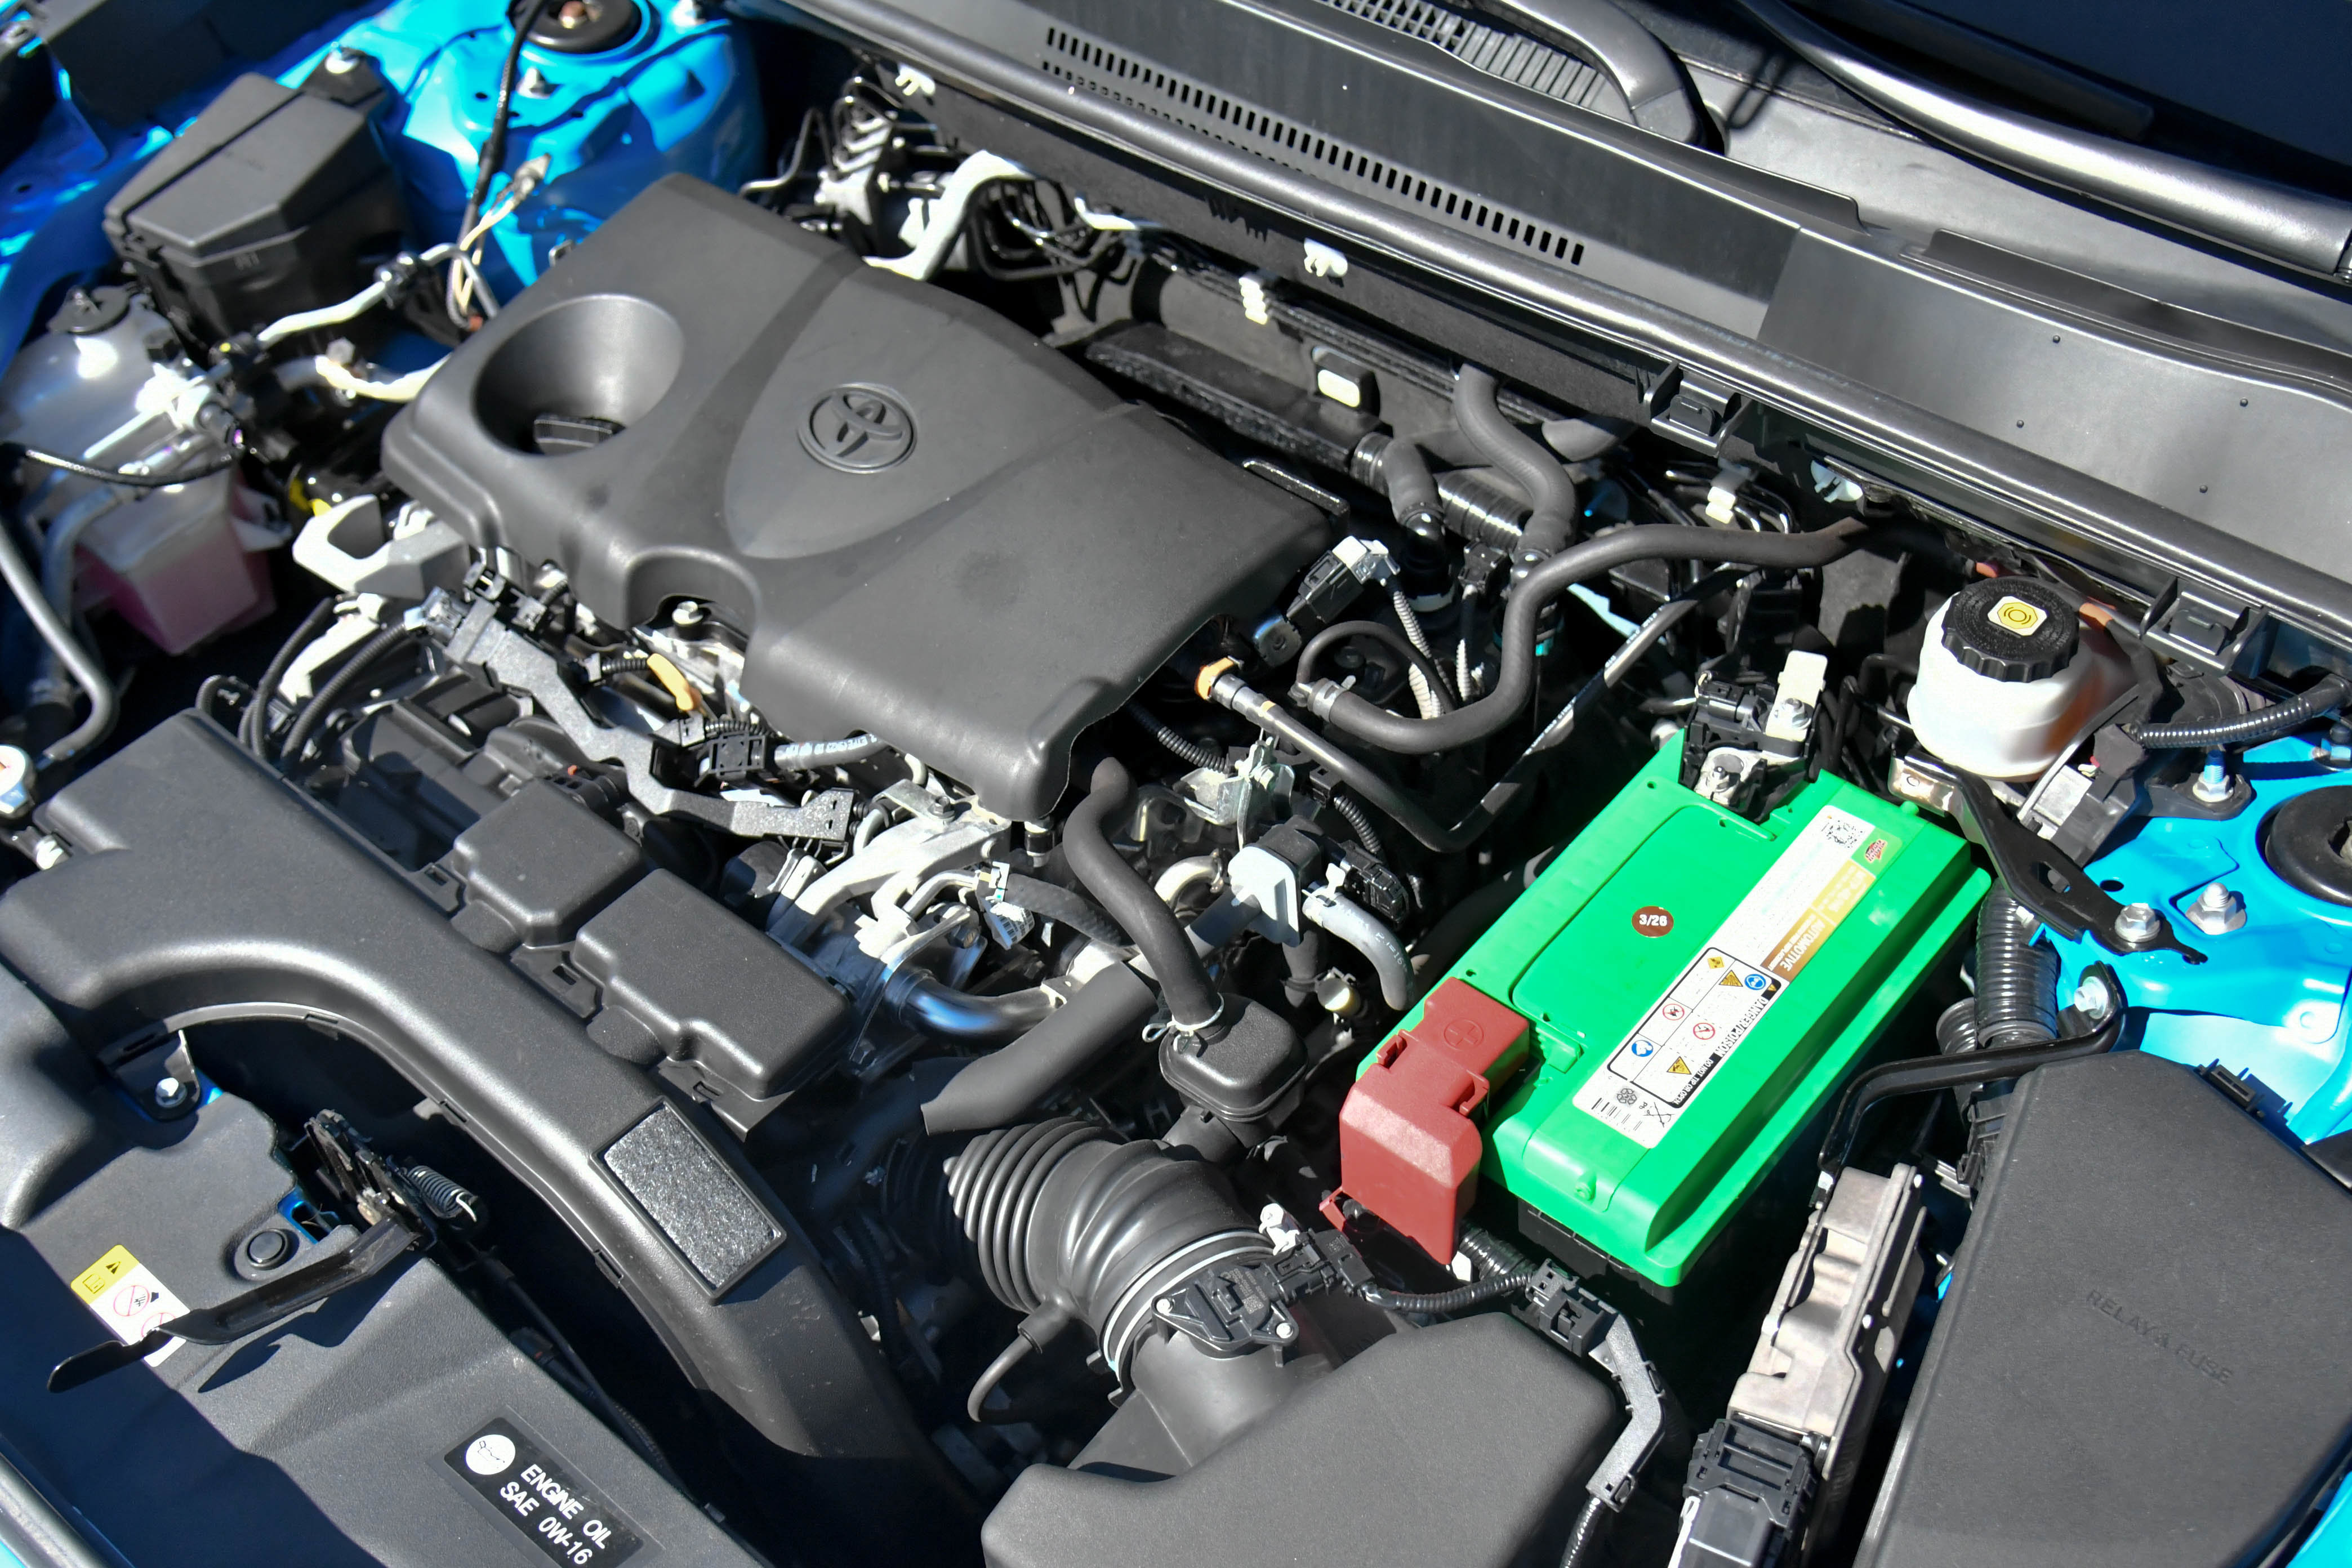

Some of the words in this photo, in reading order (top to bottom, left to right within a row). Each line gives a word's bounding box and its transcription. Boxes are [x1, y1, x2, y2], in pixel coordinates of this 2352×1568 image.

[1869, 841, 1886, 862] INTERSTATE
[1639, 914, 1668, 926] 3/26
[1780, 919, 1825, 972] AUTOMOTIVE
[1714, 996, 1769, 1058] DANGER/POISON
[1696, 1065, 1708, 1077] NOT
[1703, 1058, 1714, 1067] DO
[1683, 1083, 1693, 1093] OR
[1690, 1076, 1700, 1086] TIP
[2086, 1290, 2159, 1335] RELAY
[2175, 1343, 2233, 1384] FUSE
[521, 1464, 584, 1520] ENGINE
[583, 1520, 612, 1549] OIL
[500, 1481, 540, 1516] SAE
[538, 1517, 593, 1565] 0W-16
